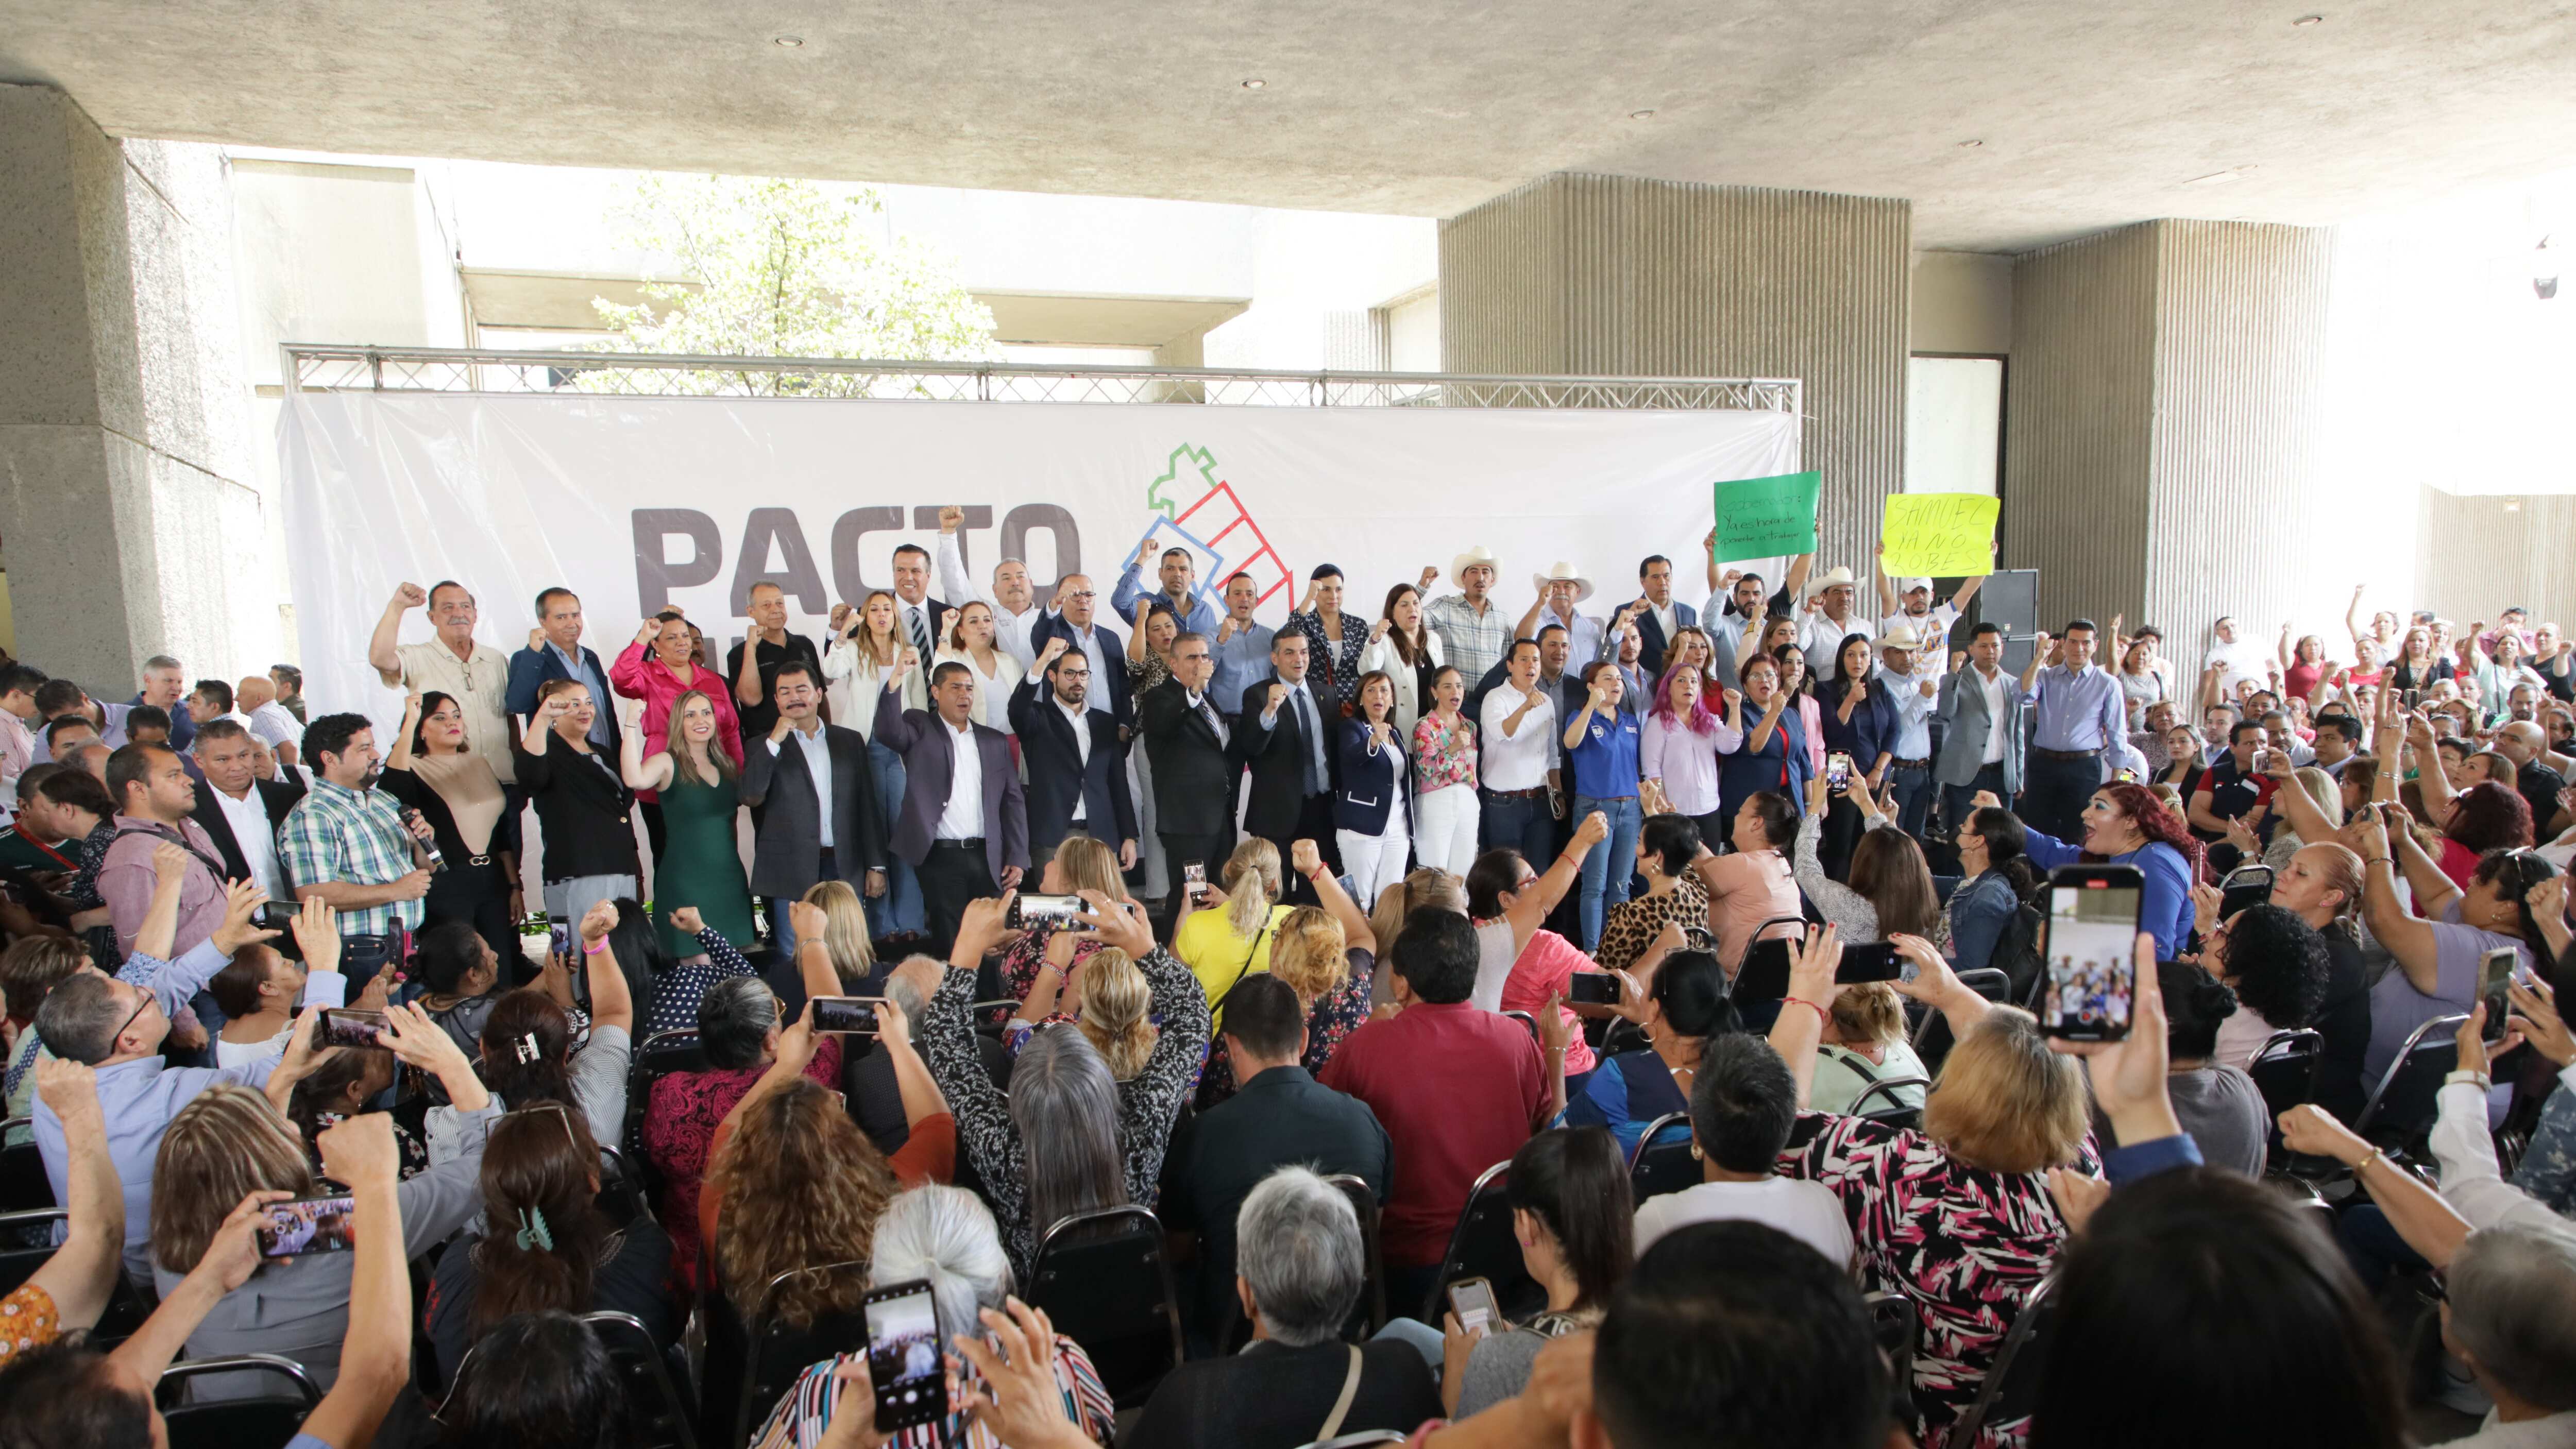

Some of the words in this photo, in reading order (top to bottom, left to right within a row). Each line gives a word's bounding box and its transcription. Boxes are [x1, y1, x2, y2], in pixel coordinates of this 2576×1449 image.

[1723, 514, 1738, 531] Ya
[1740, 521, 1755, 529] es
[1756, 517, 1780, 527] hora
[1784, 511, 1796, 524] de
[1889, 498, 1988, 530] SAMUEL
[1899, 530, 1920, 550] YA
[1925, 533, 1967, 551] NO
[631, 503, 1081, 619] PACTO
[1890, 549, 1979, 577] ROBES
